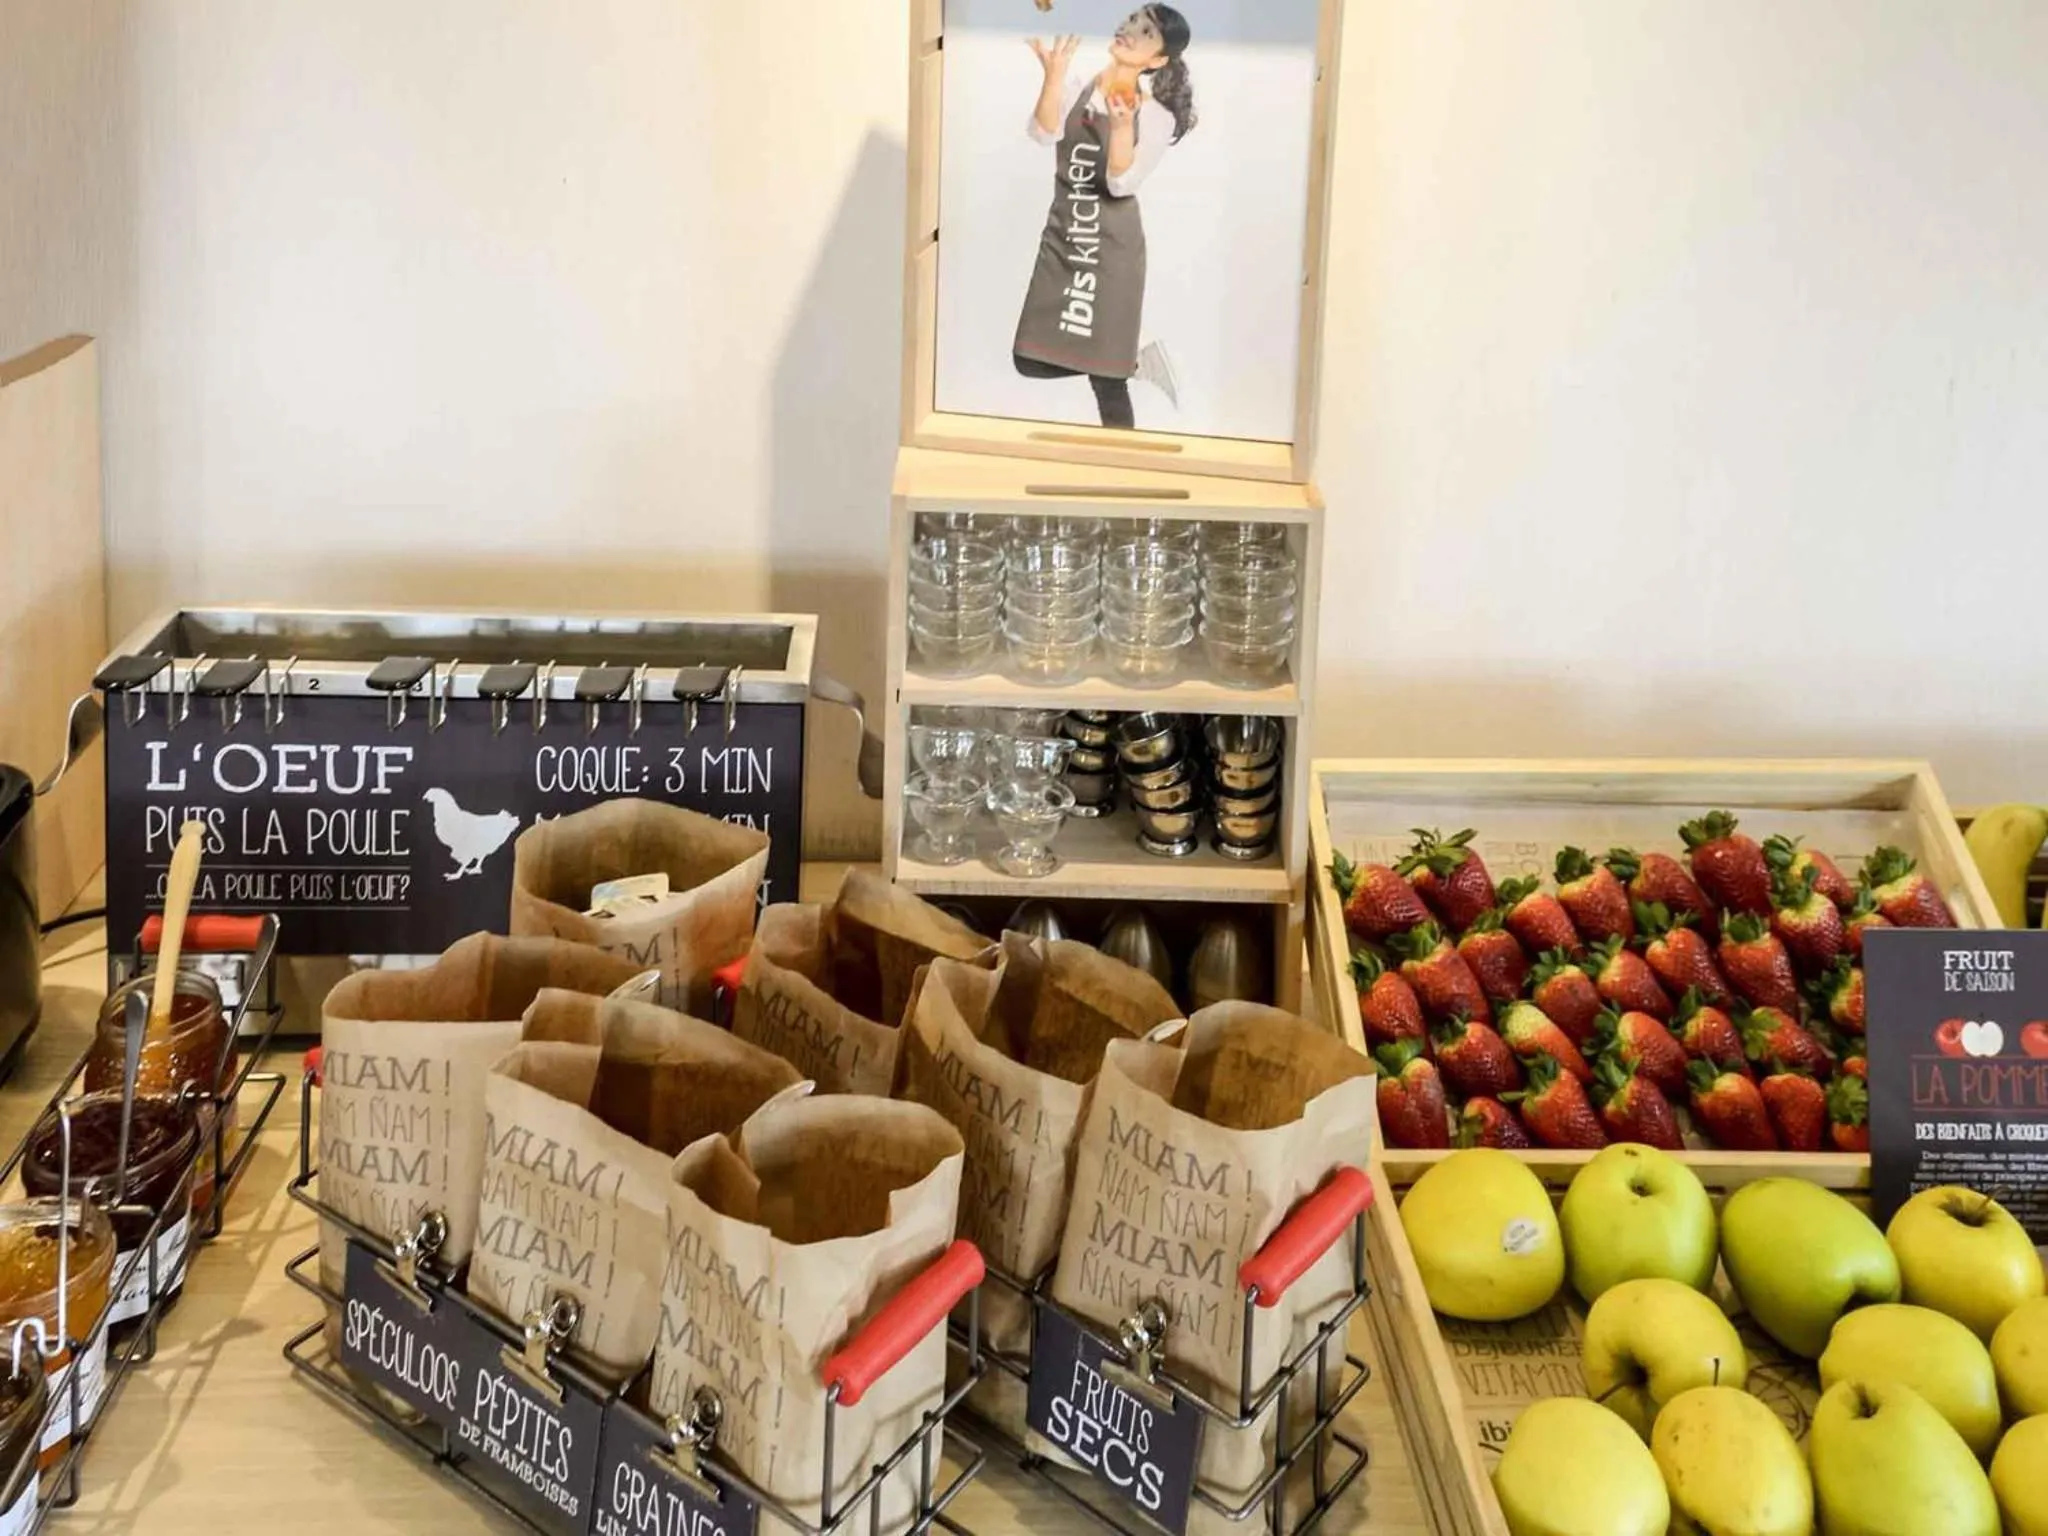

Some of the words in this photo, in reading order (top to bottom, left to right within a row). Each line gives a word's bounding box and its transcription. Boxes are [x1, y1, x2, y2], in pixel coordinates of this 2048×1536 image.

[1066, 142, 1100, 264] kitchen
[1060, 271, 1097, 337] ibis
[308, 678, 320, 691] 2
[145, 741, 414, 794] L'OEUF
[536, 746, 649, 795] COQUE:
[665, 748, 686, 794] 3
[701, 747, 773, 794] MIN
[242, 807, 288, 856] LA
[306, 808, 411, 856] POULE
[224, 874, 282, 901] POULE
[290, 875, 333, 901] PUIS
[1943, 951, 2014, 970] FRUIT
[1945, 972, 1961, 991] DE
[1966, 972, 2015, 991] SAISON
[1911, 1063, 1949, 1104] LA
[484, 1112, 606, 1200] MIAM
[1108, 1104, 1232, 1198] MIAM
[1087, 1200, 1227, 1289] MIAM
[1159, 1190, 1228, 1245] ÑAM
[344, 1298, 461, 1412] SPÉCULOOS
[473, 1367, 573, 1483] PÉPITES
[1070, 1359, 1153, 1454] FRUITS
[1457, 1362, 1596, 1399] VITAMIN
[1046, 1396, 1165, 1510] SECS
[1478, 1420, 1513, 1443] ibi
[458, 1417, 483, 1445] DE
[482, 1434, 580, 1518] FRAMBOISES
[612, 1461, 728, 1536] GRAIN
